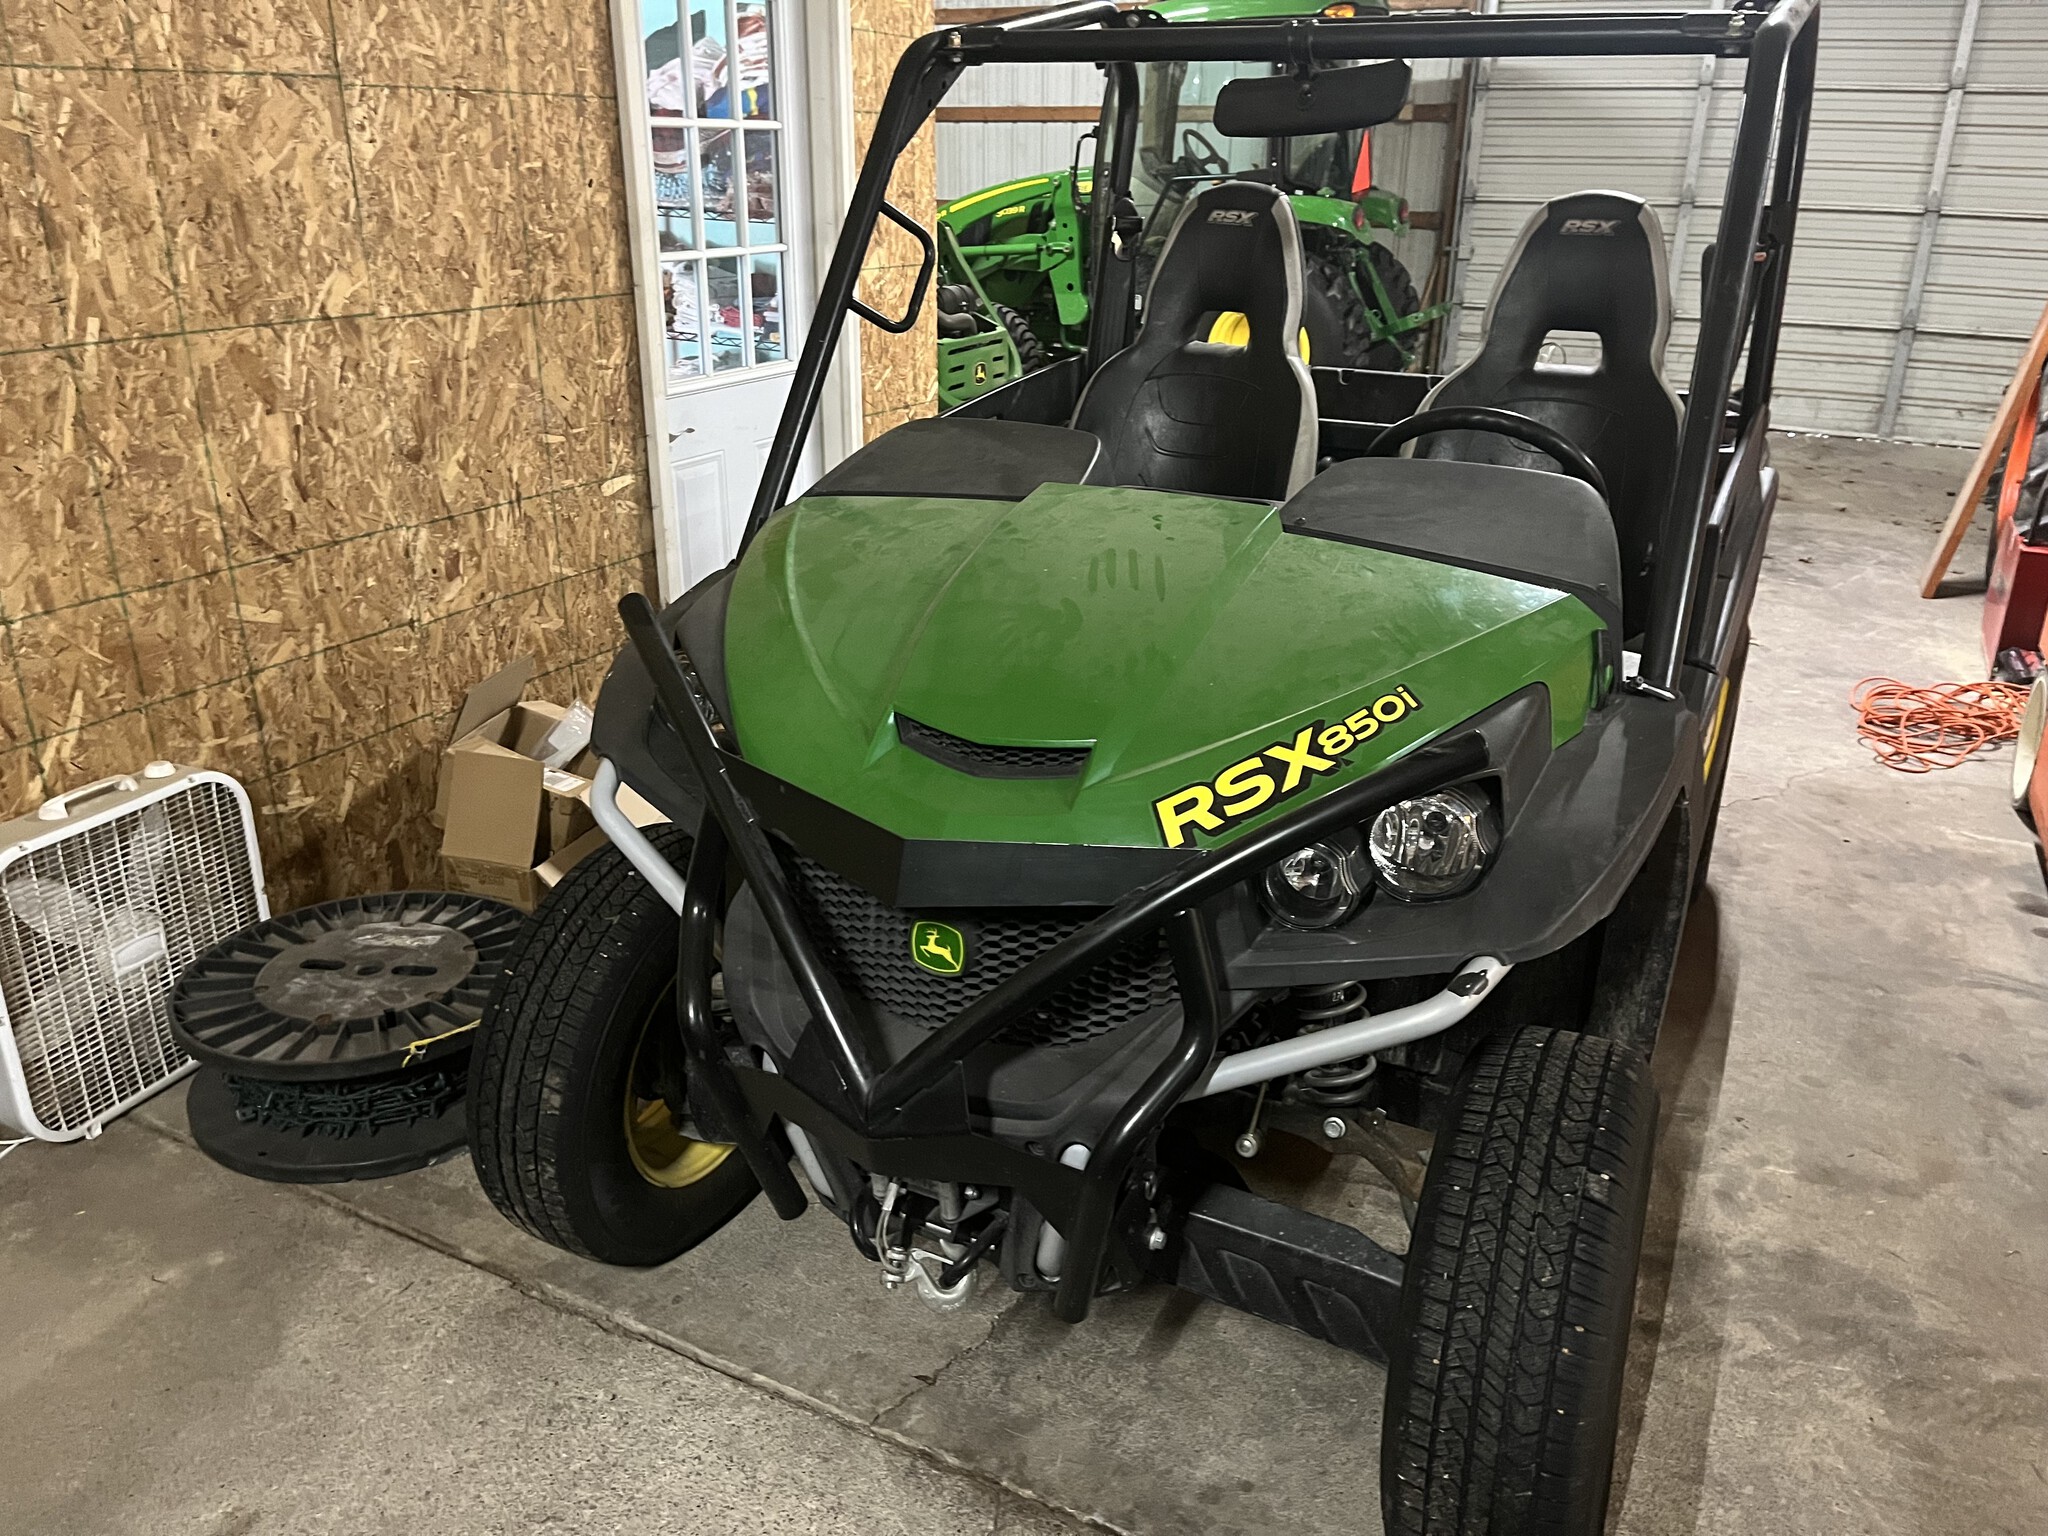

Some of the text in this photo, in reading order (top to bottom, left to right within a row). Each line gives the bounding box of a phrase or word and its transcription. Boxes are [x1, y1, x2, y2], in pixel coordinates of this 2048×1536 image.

[1207, 209, 1259, 227] RSX
[1560, 218, 1622, 236] RSX
[1154, 685, 1421, 848] RSX 850i
